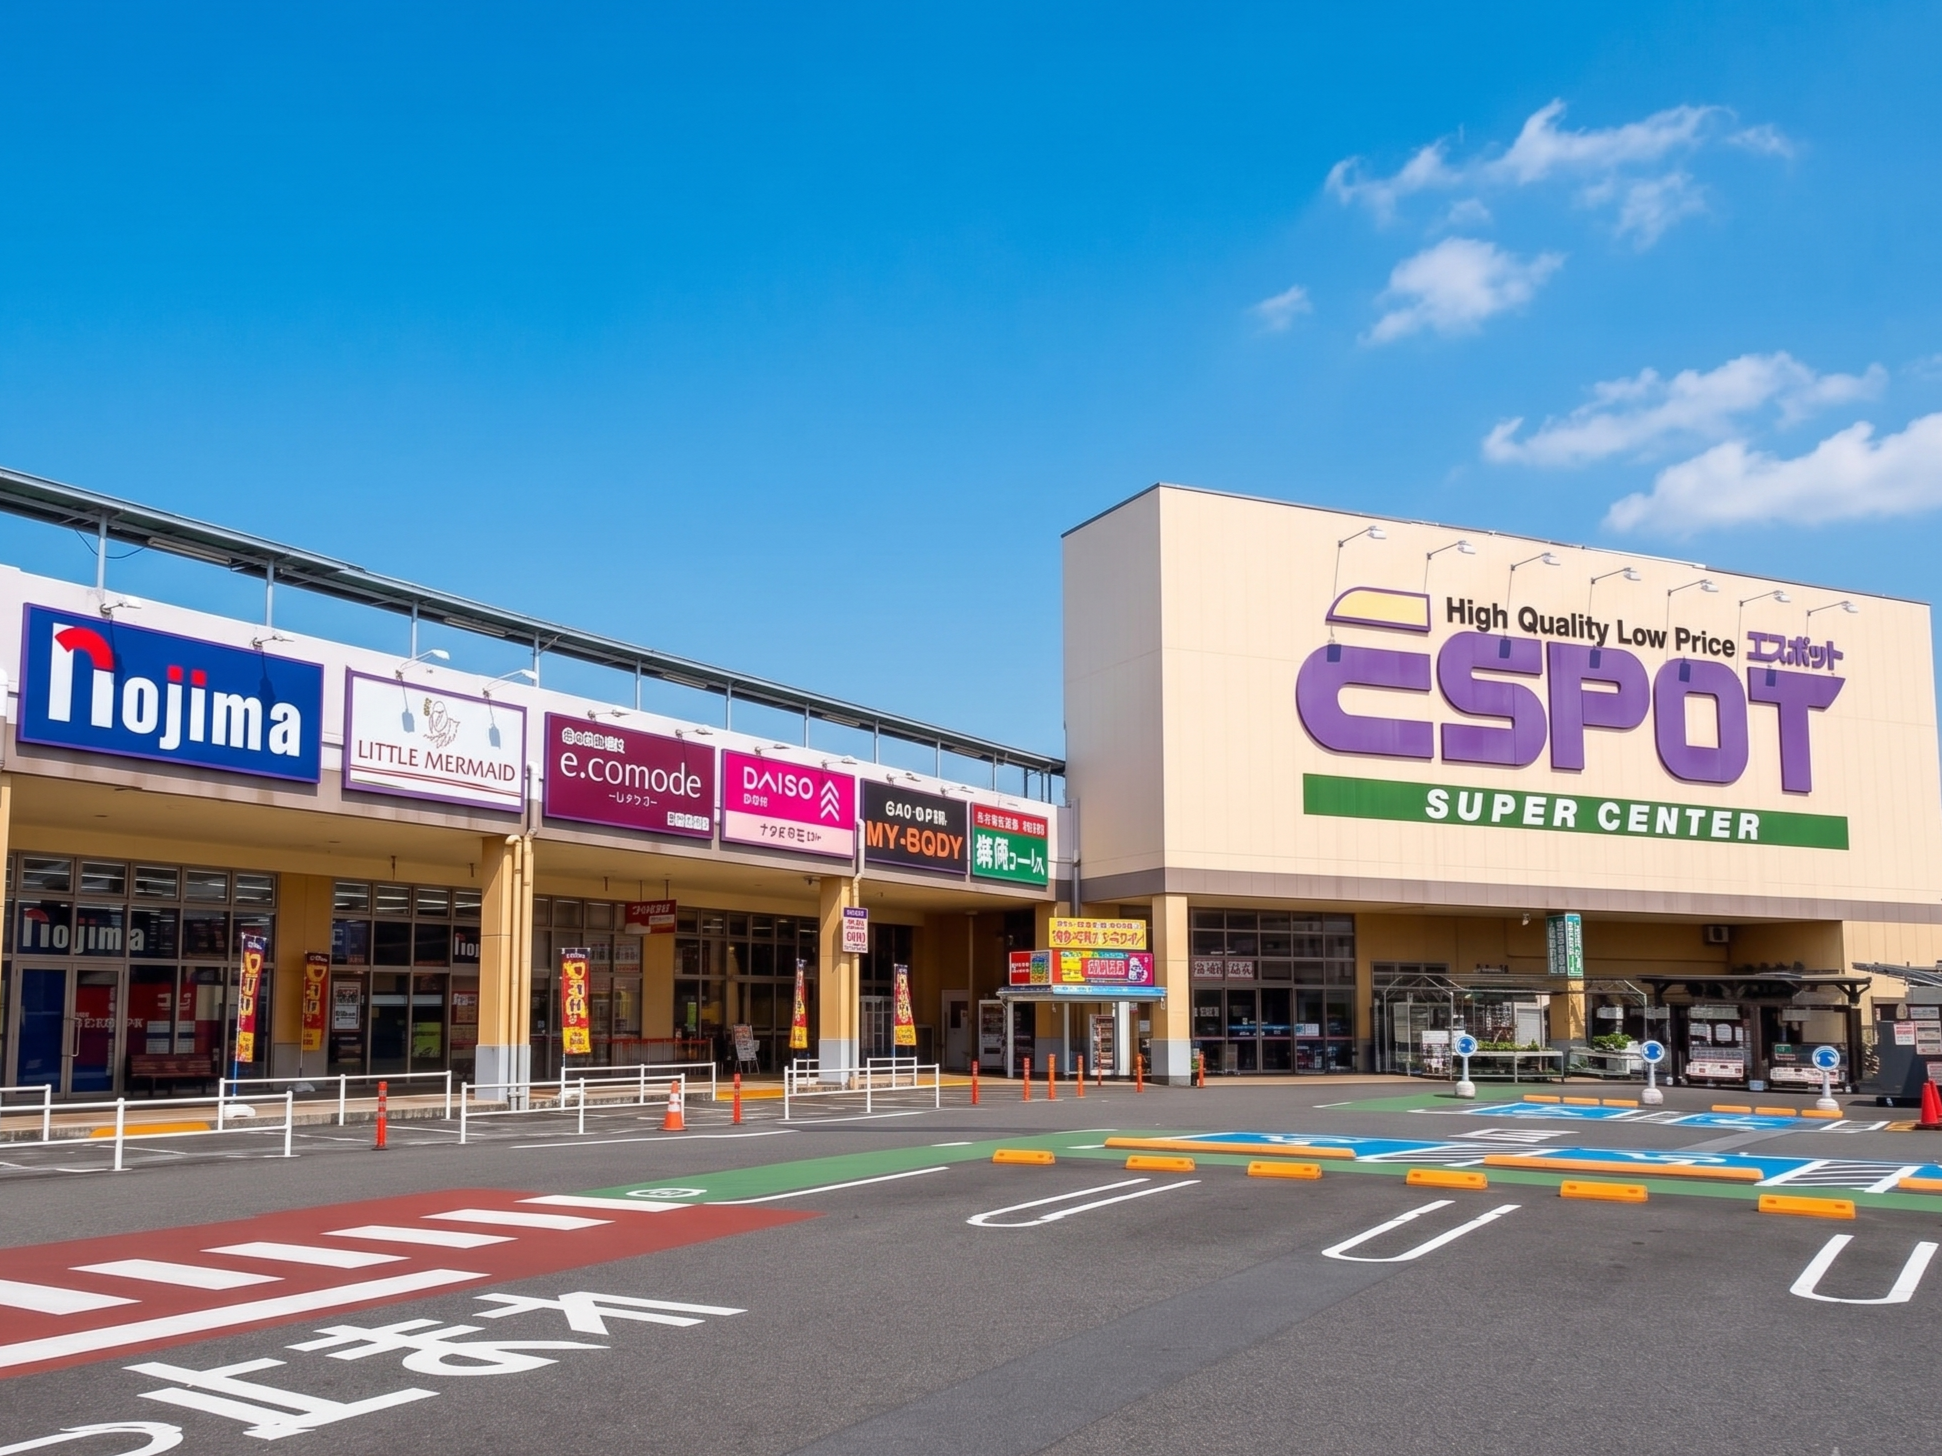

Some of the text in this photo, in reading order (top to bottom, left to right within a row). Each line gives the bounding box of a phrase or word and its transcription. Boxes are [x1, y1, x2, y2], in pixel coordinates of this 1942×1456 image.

[1446, 597, 1736, 658] High Quality Low Price
[1746, 631, 1844, 671] エスポット
[48, 622, 300, 757] nojima
[1296, 587, 1846, 794] ESPOT
[358, 739, 516, 782] LITTLE MERMAID
[560, 752, 702, 798] e.comode
[743, 766, 814, 800] DAISO
[1425, 788, 1761, 841] SUPER CENTER
[22, 908, 145, 954] nojima
